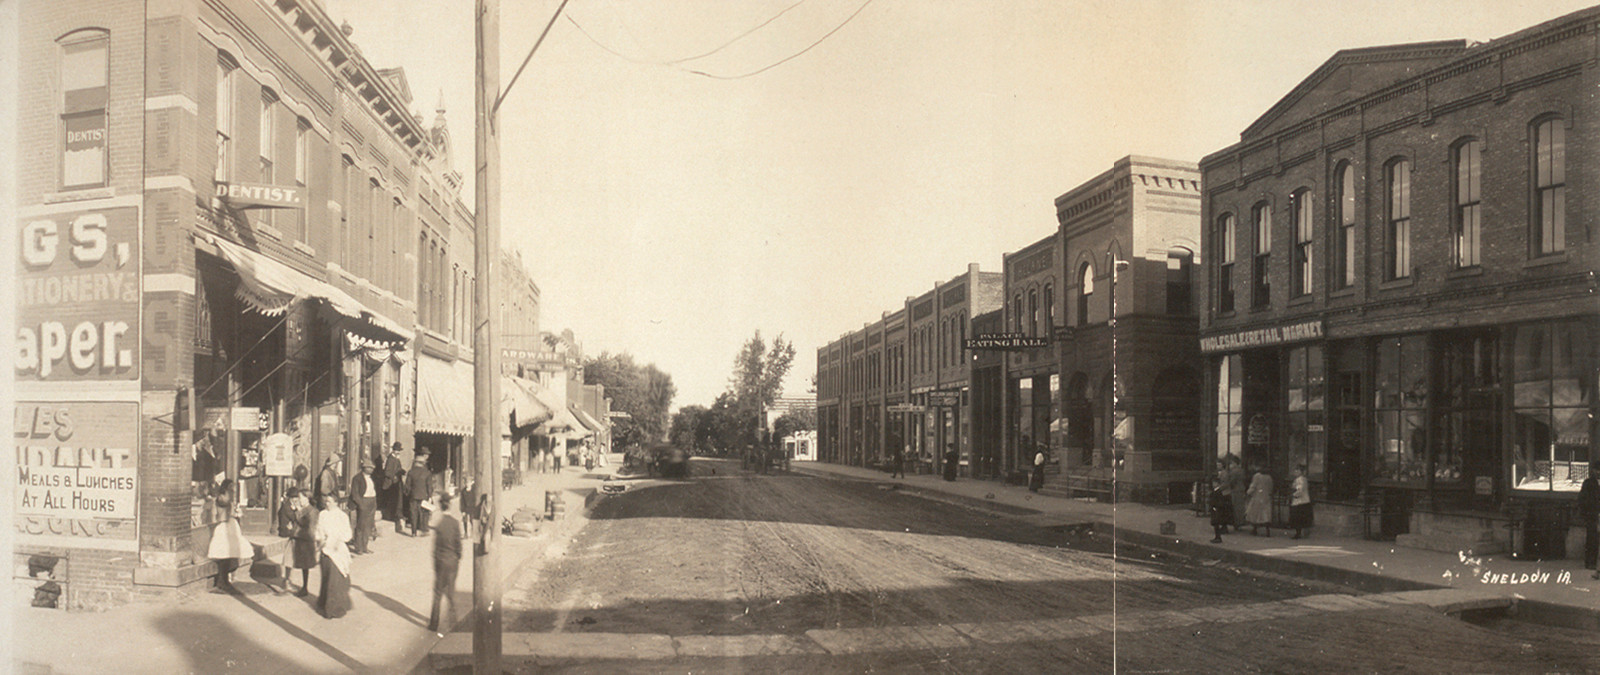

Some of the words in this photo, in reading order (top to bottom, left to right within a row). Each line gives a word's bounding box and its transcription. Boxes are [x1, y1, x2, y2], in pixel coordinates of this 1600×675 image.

[217, 185, 301, 203] DENTIST.
[1282, 321, 1323, 341] MARKET
[967, 339, 1009, 348] EATING
[19, 467, 60, 487] MEALS
[64, 476, 72, 487] &
[76, 467, 134, 490] LUNCHES
[22, 489, 38, 507] AT
[43, 490, 66, 509] ALL
[72, 491, 115, 512] HOURS
